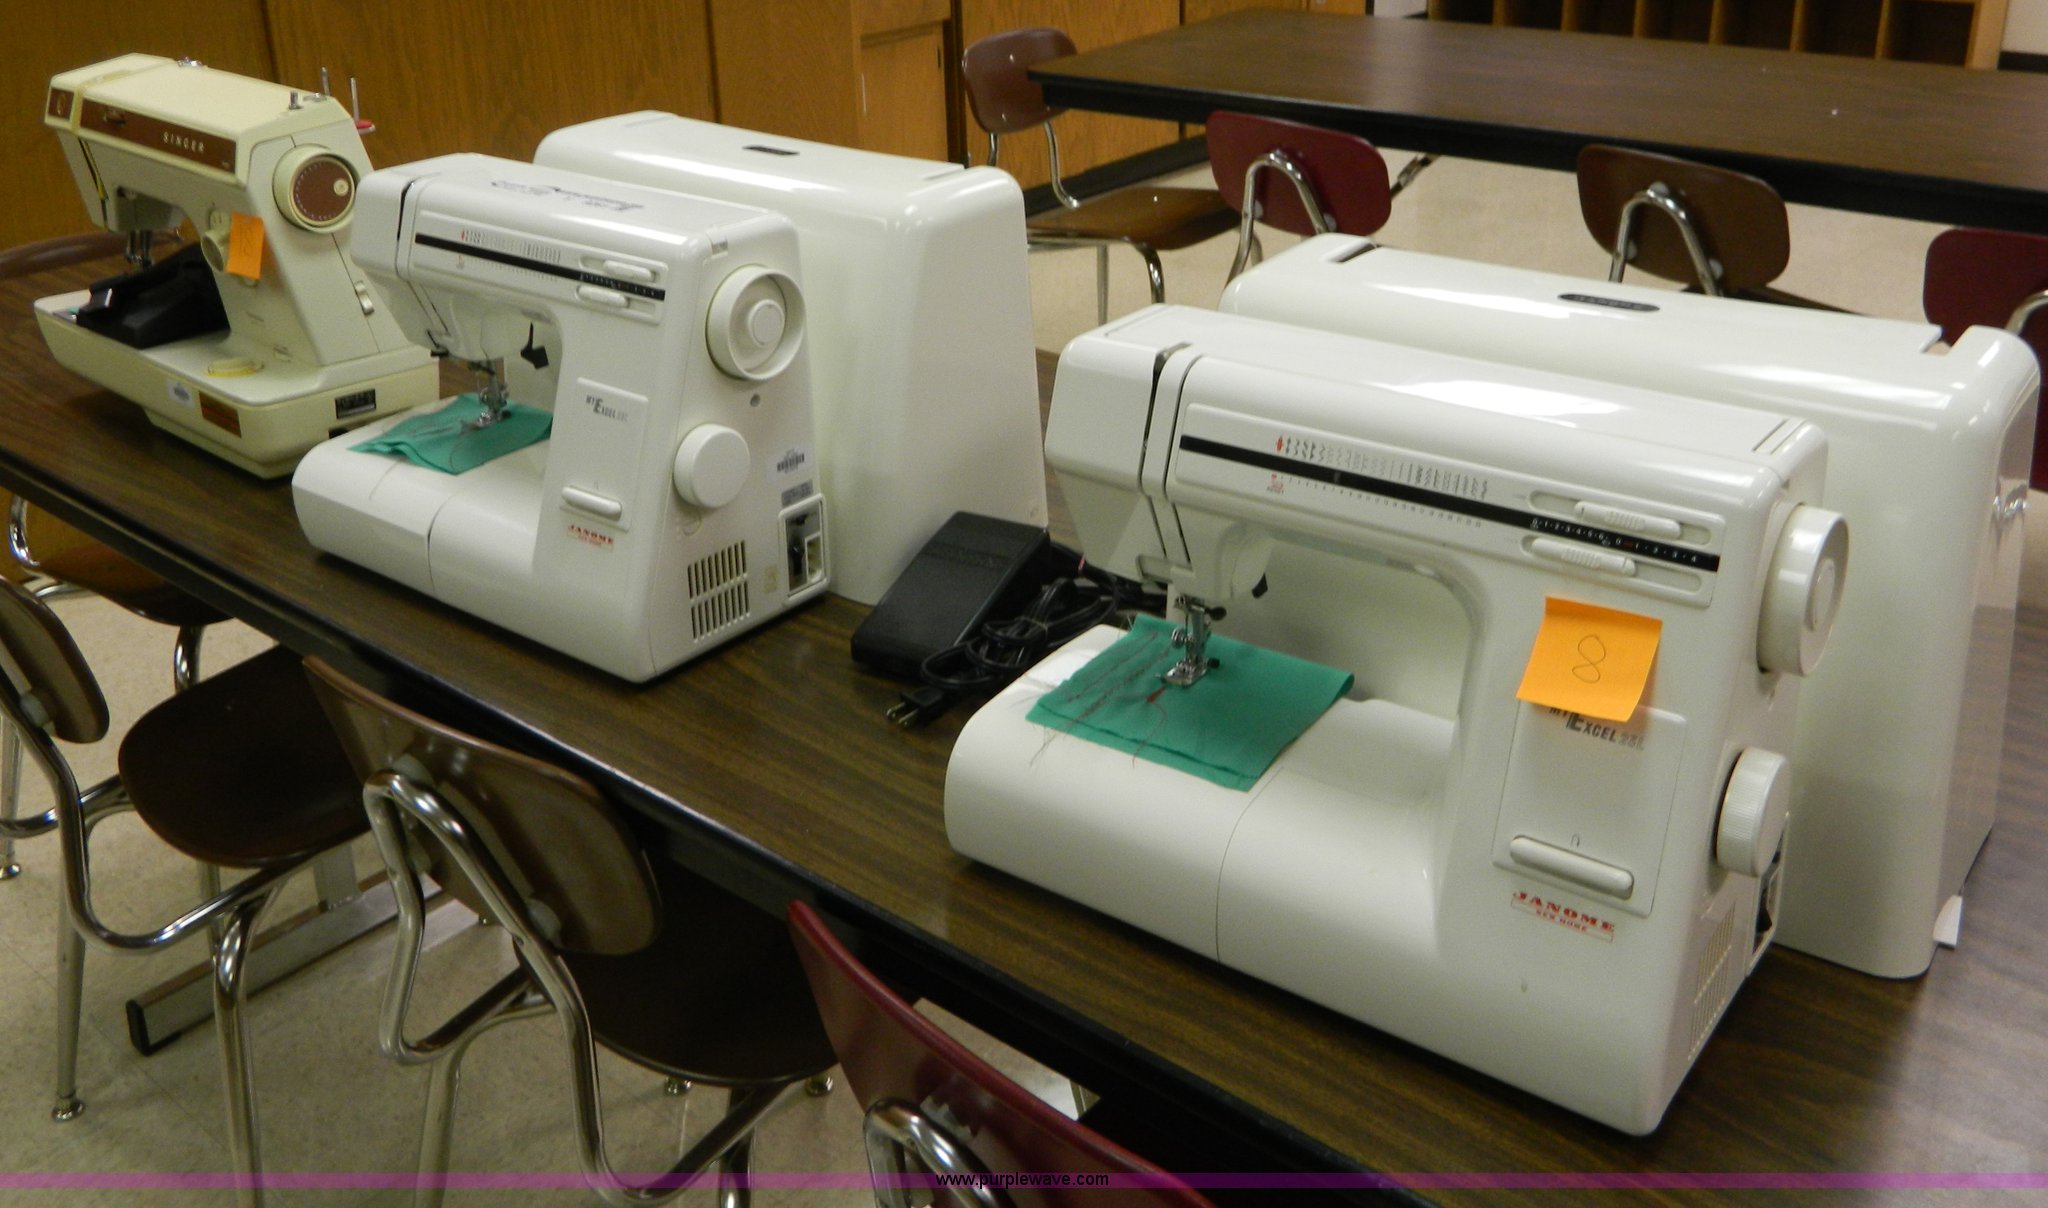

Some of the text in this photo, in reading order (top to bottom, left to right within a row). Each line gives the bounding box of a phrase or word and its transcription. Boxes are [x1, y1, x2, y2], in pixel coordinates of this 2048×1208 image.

[163, 131, 205, 153] SINGER
[568, 524, 613, 545] JANOME
[1572, 634, 1606, 683] 8
[1512, 891, 1614, 934] JANOME
